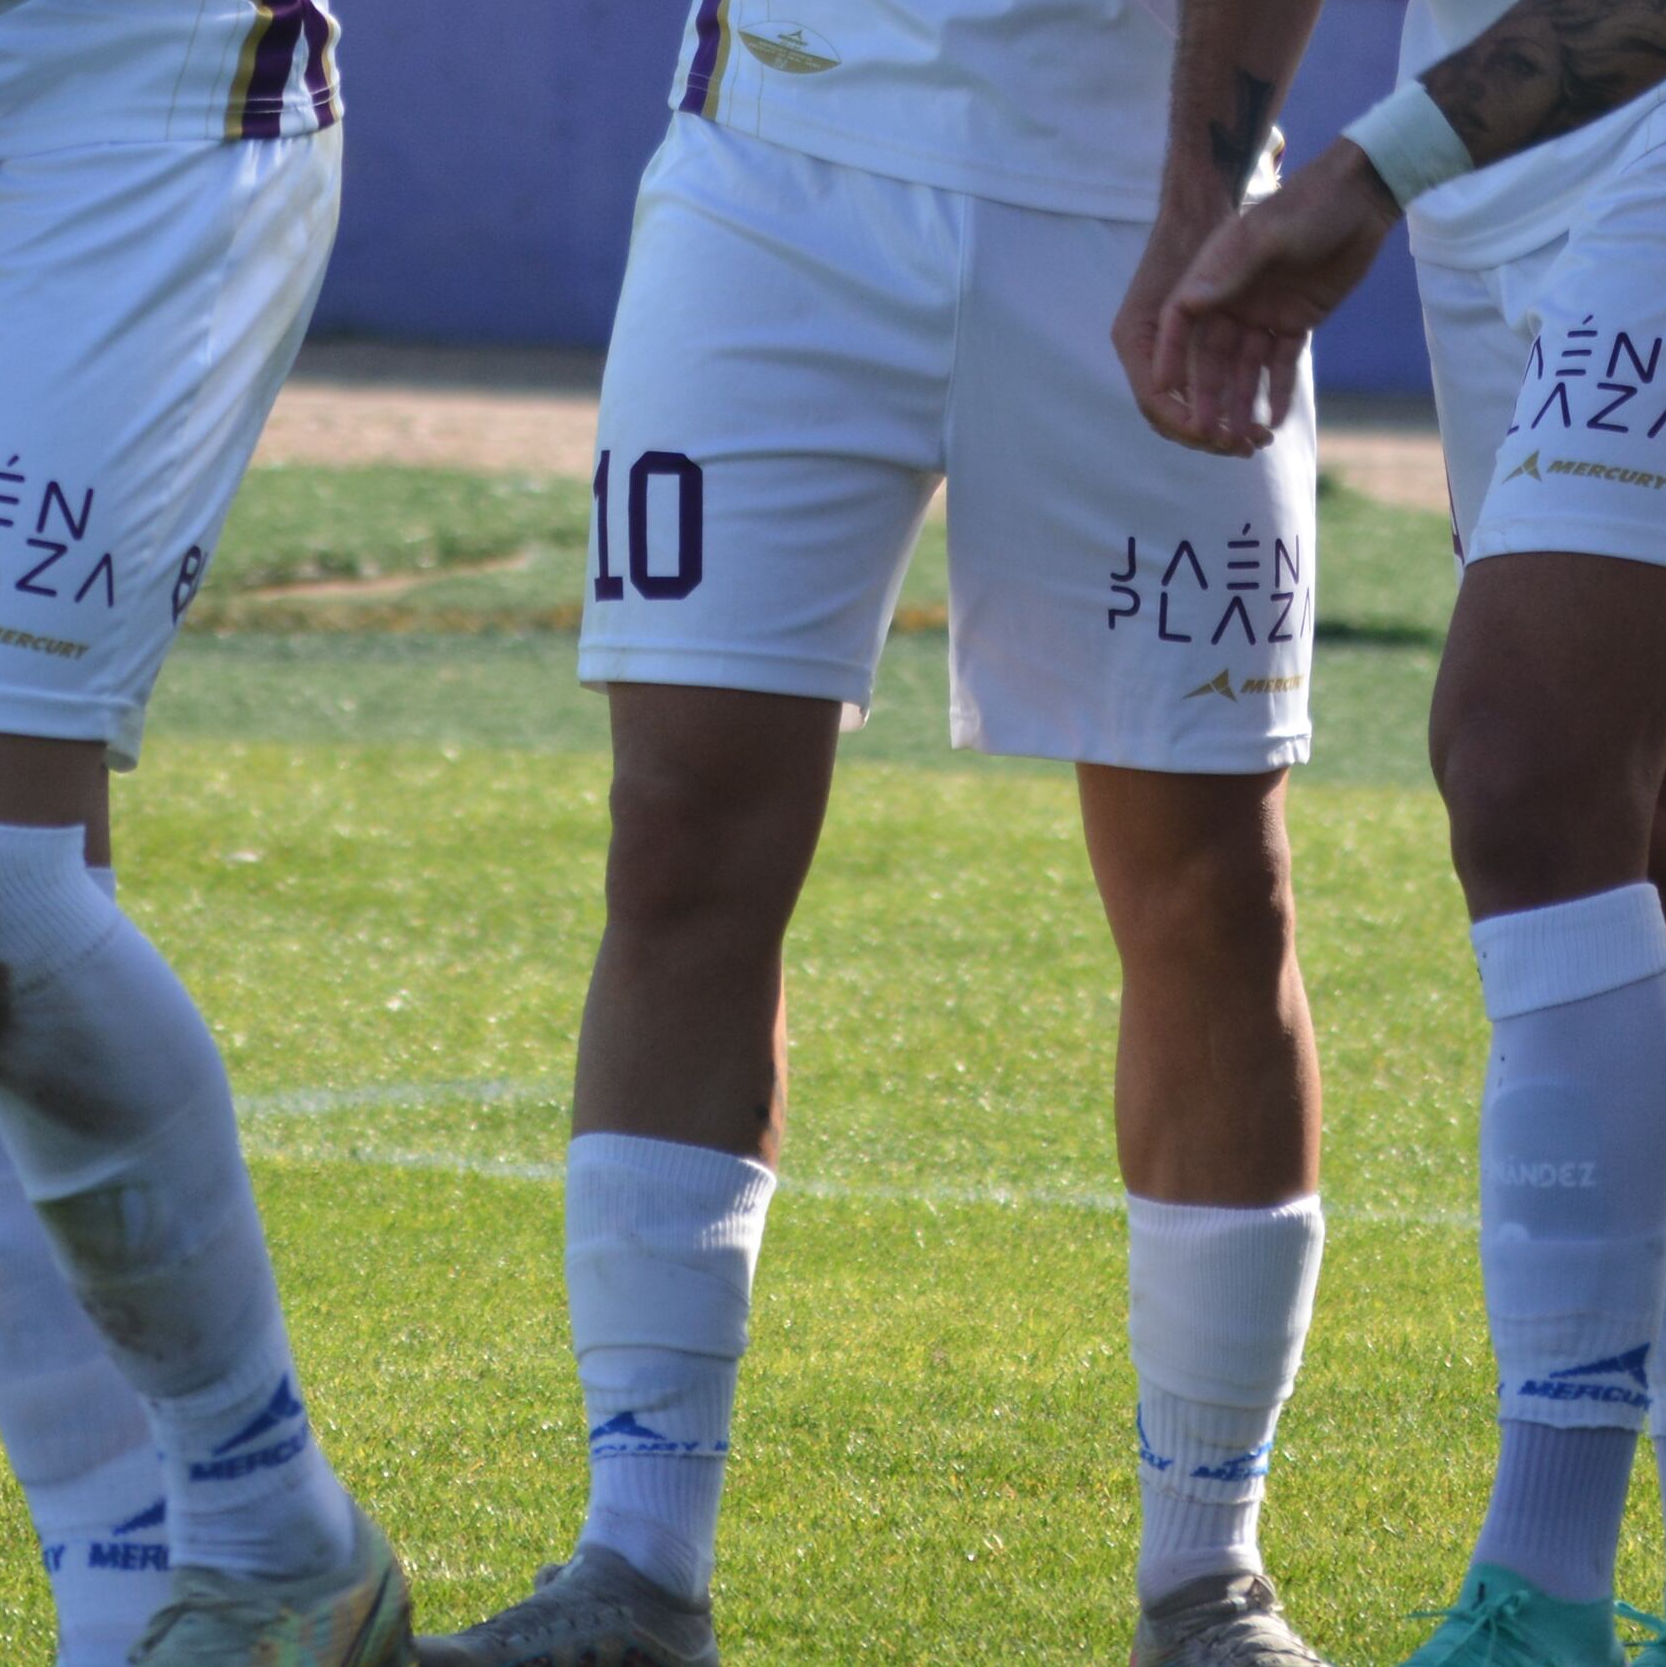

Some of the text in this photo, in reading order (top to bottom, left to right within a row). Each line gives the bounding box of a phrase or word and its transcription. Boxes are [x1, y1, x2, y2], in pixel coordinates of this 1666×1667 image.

[1524, 314, 1663, 384] AÉN
[593, 449, 703, 602] 10
[1110, 522, 1300, 590] JAÉN
[1108, 584, 1312, 645] PLAZA
